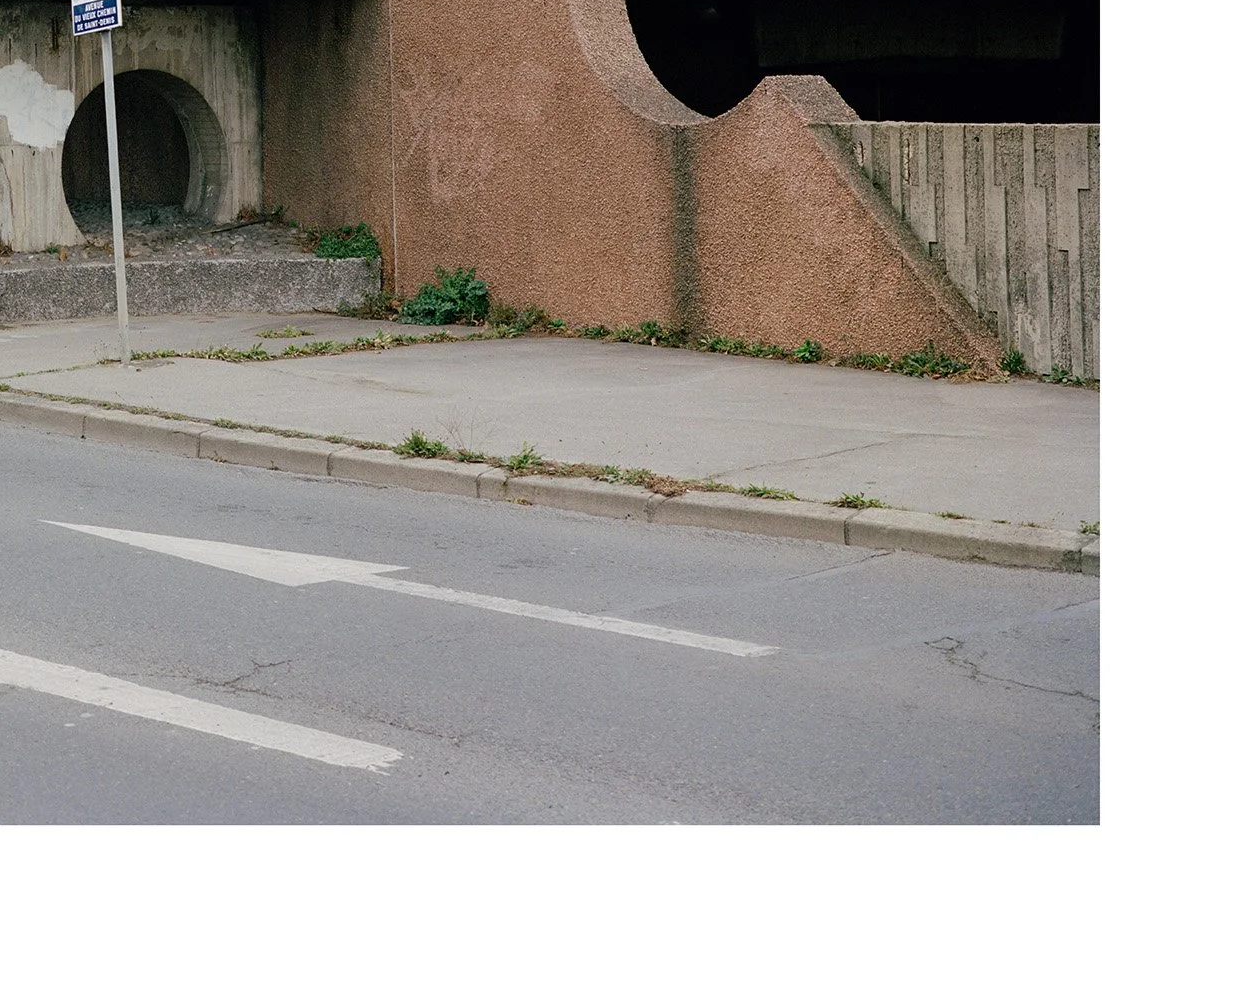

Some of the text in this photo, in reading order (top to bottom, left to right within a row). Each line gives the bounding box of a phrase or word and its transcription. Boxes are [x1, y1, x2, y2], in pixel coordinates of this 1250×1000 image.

[85, 0, 104, 11] AVENUE
[75, 6, 116, 23] DU VIEUX CHEMIN
